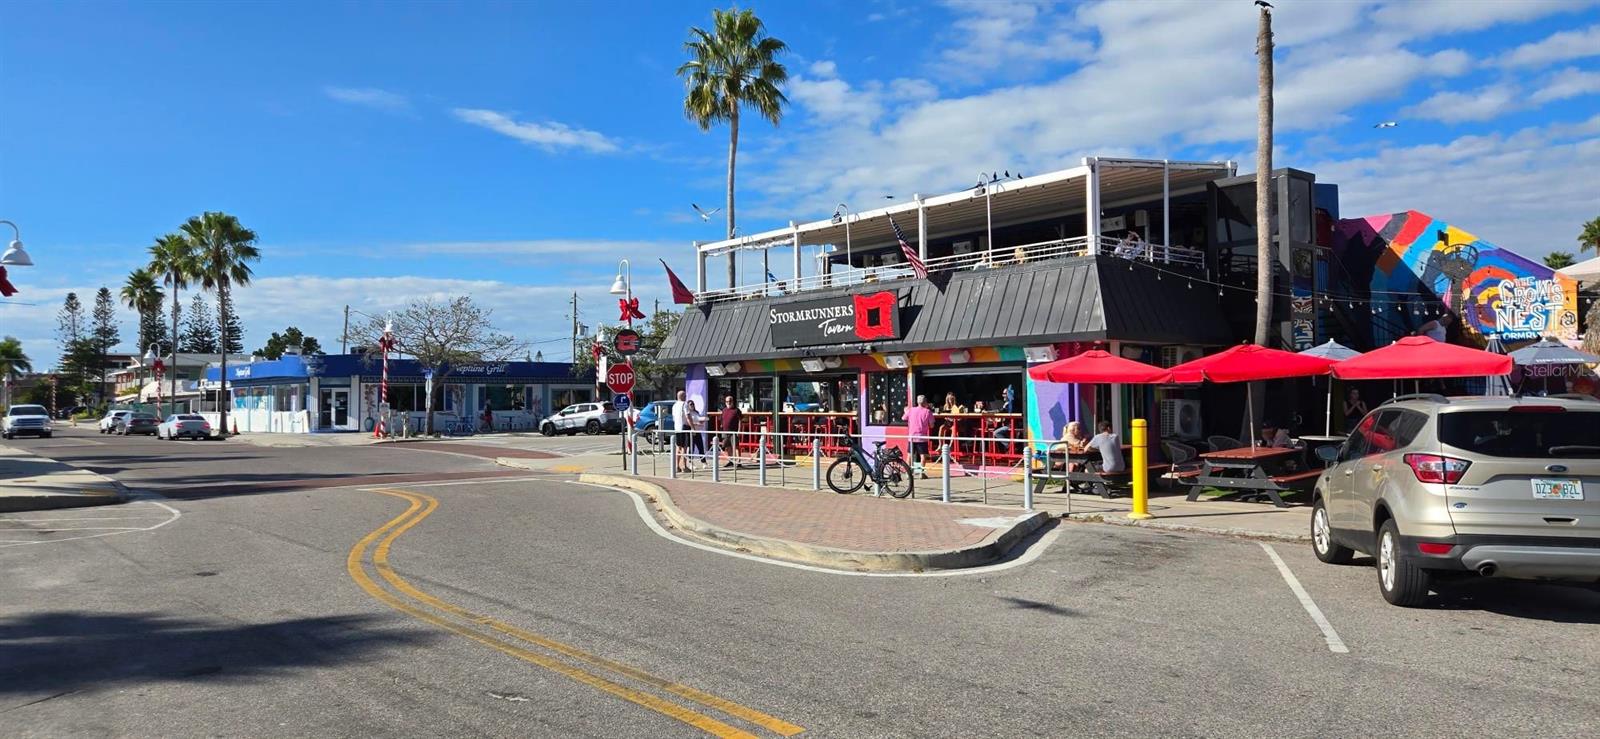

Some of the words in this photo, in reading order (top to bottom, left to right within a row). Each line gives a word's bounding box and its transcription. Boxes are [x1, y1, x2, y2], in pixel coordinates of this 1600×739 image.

[1496, 302, 1564, 332] NEST
[818, 318, 854, 337] Tavern
[486, 364, 505, 375] Grill
[609, 373, 633, 385] STOP
